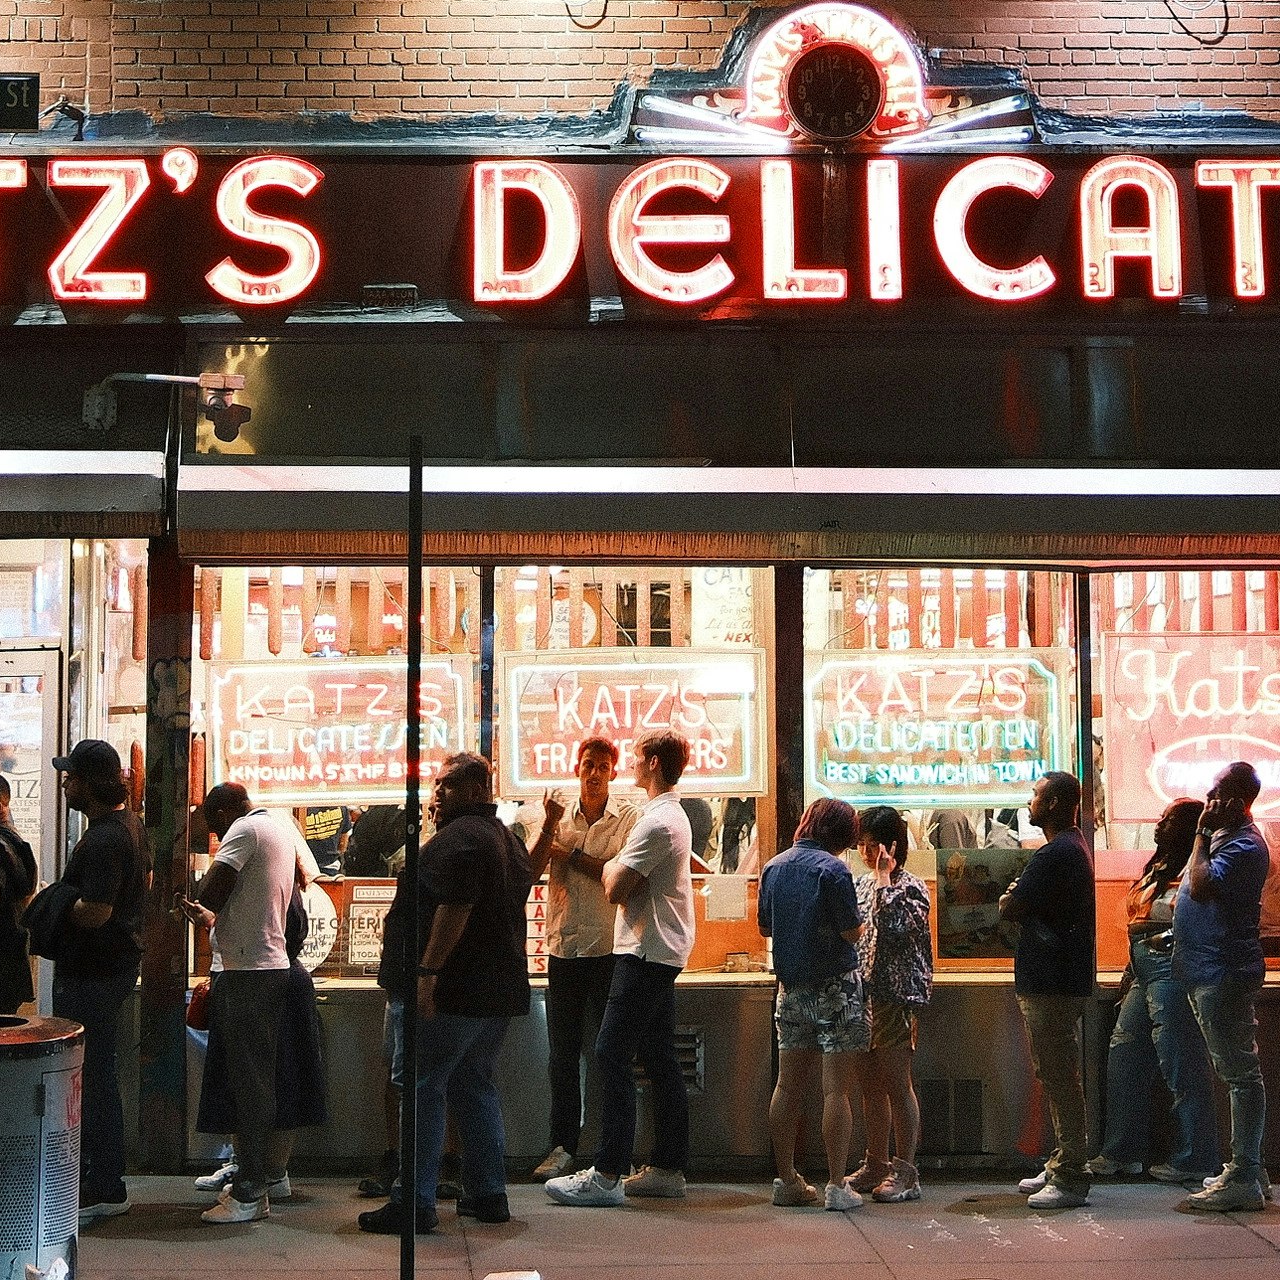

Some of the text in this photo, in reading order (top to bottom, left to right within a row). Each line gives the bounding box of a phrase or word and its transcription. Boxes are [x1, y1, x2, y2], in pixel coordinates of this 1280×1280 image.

[6, 81, 30, 108] St
[724, 632, 753, 644] NEX
[556, 679, 708, 730] KATZ'S
[835, 663, 1026, 719] KATZ'S
[835, 721, 1037, 753] DELICATESSEN
[229, 764, 305, 782] KNOWN
[308, 762, 339, 780] AS
[388, 761, 442, 778] BST
[826, 762, 869, 783] BEST
[877, 763, 969, 785] SANDWICH
[994, 760, 1047, 782] TOWN
[533, 886, 547, 972] KATZ'S
